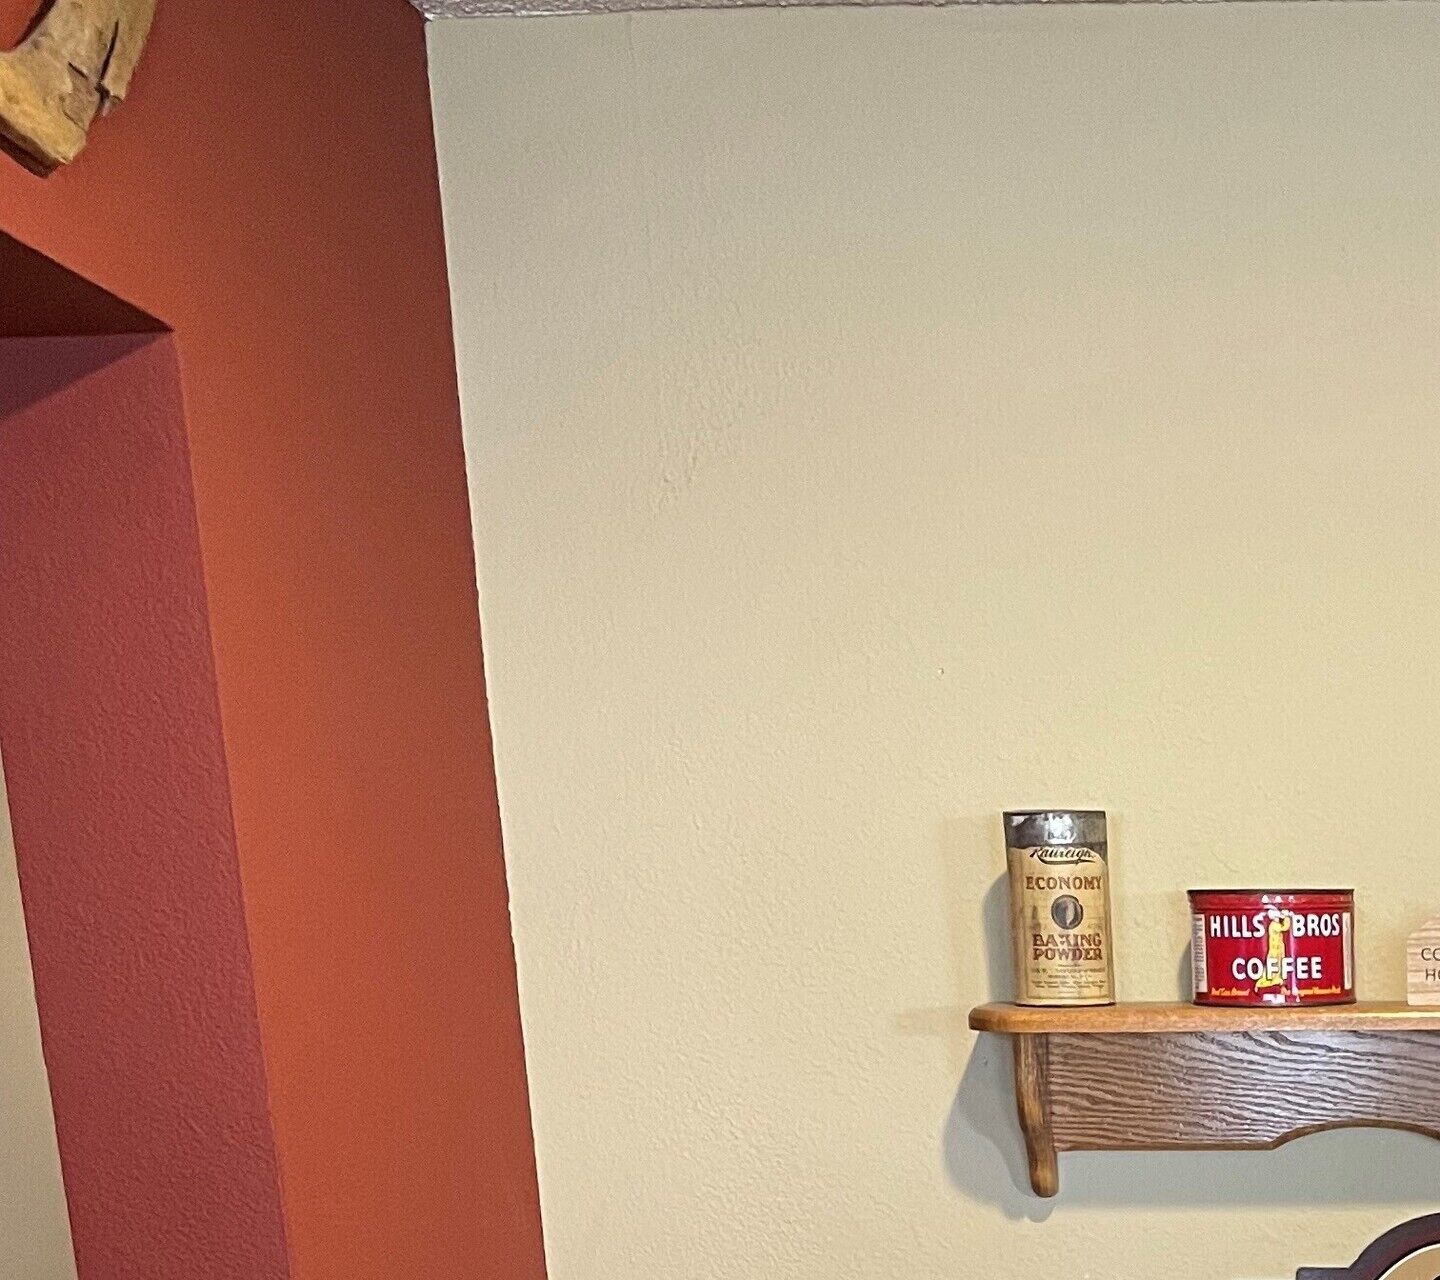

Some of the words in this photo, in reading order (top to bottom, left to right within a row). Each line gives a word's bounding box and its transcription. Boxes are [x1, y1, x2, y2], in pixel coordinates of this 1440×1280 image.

[1026, 875, 1102, 891] ECONOMY
[1210, 911, 1267, 938] HILLS
[1292, 912, 1341, 938] BROS
[1032, 933, 1103, 947] BAKING
[1033, 947, 1103, 962] POWDER
[1231, 956, 1323, 981] COFFEE
